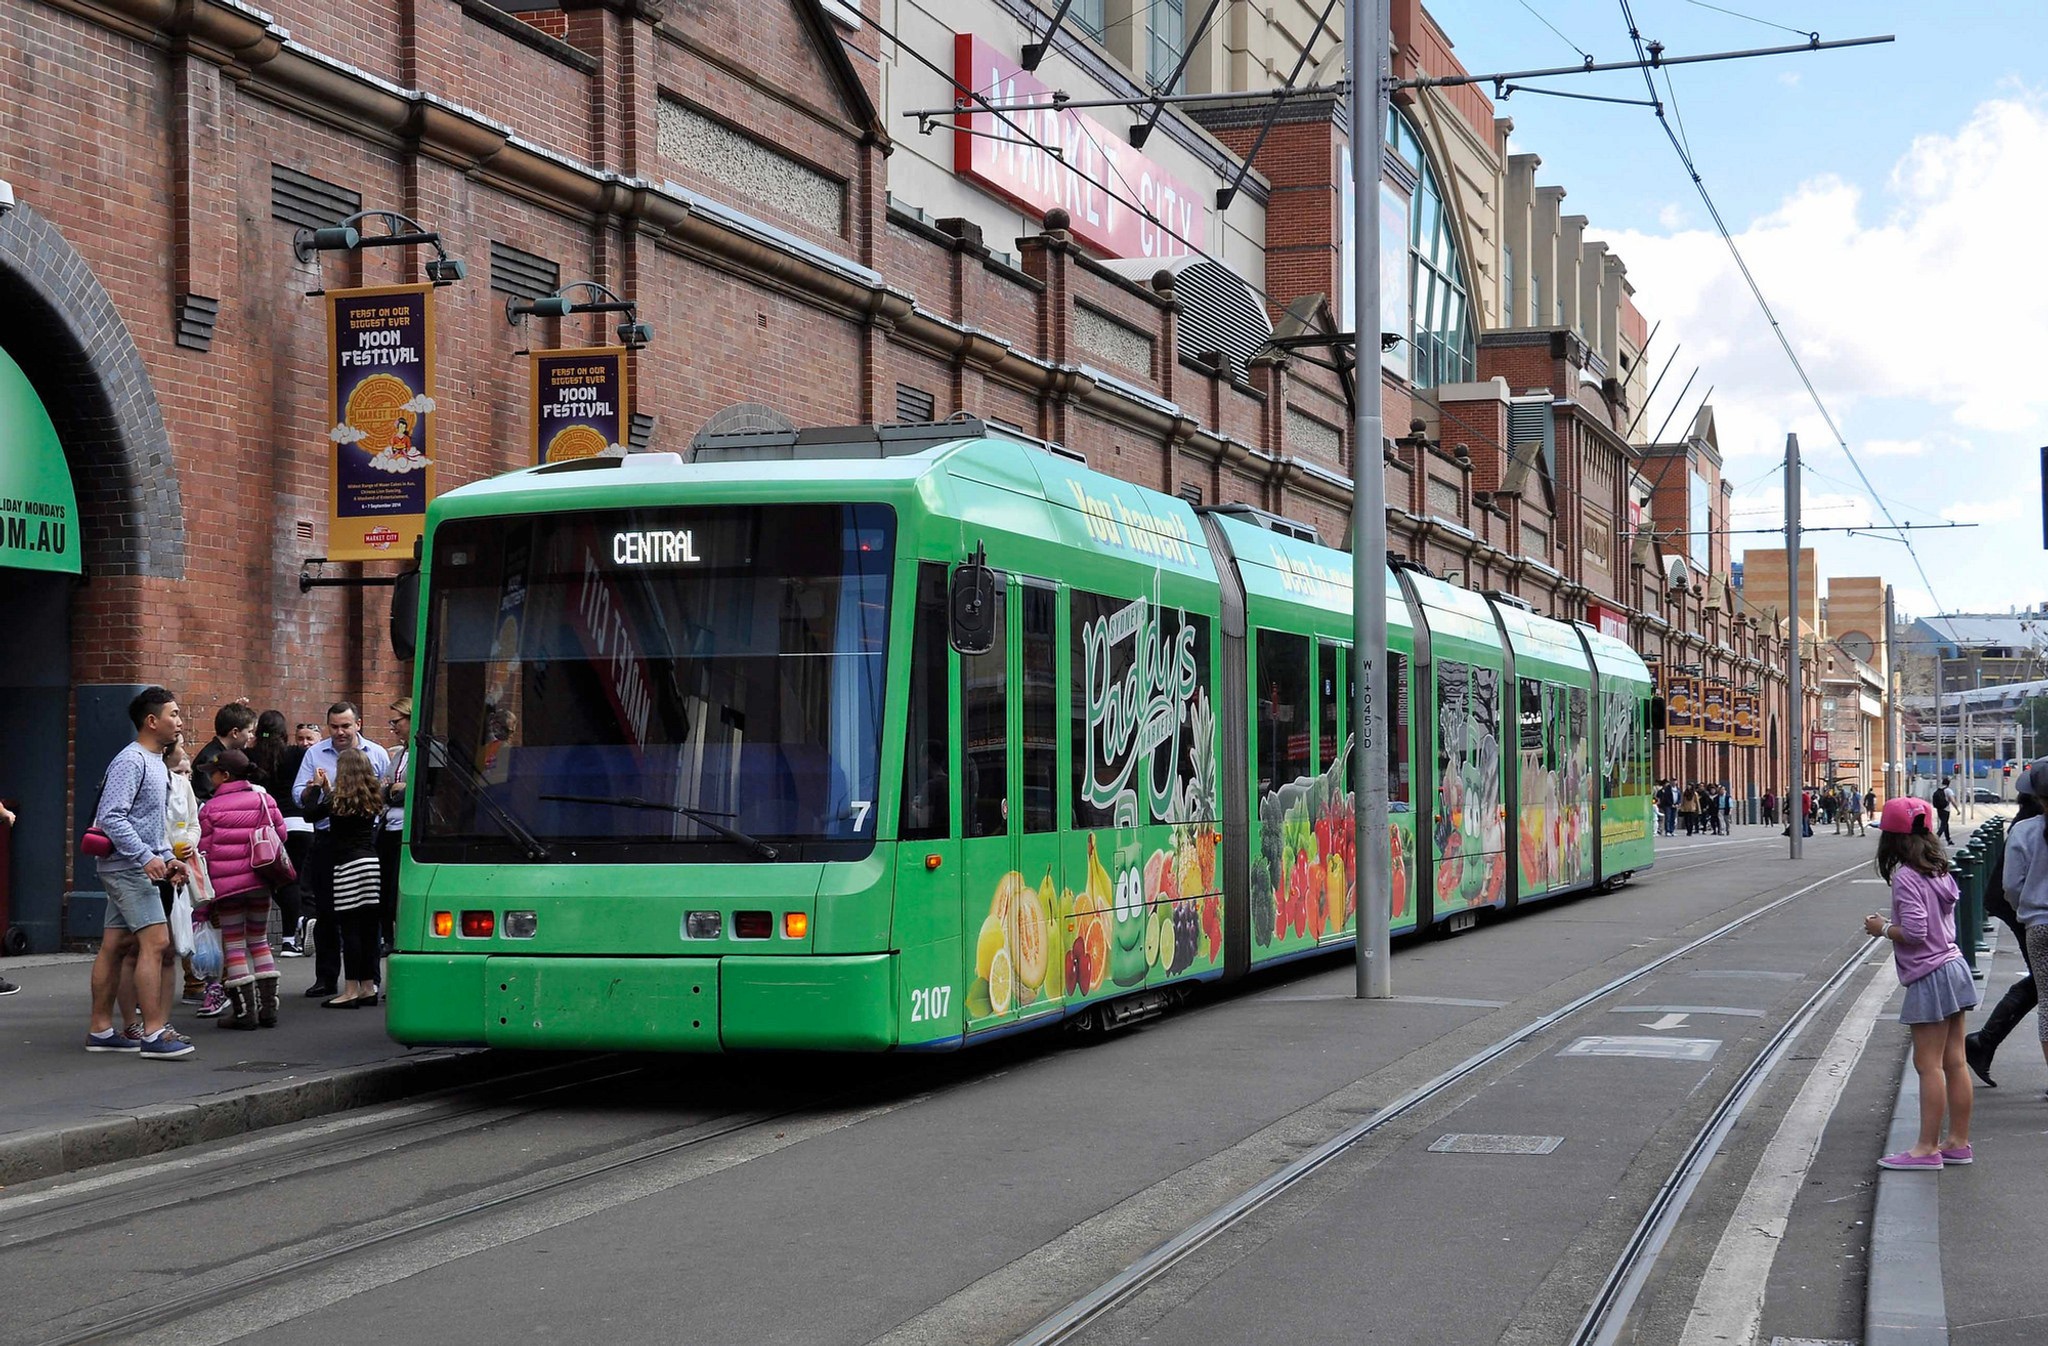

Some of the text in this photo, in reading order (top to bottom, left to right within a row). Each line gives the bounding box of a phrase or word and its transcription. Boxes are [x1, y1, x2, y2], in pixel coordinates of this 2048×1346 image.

[992, 67, 1192, 258] MARKET CITY
[350, 306, 410, 319] FEAST ON OUR
[350, 317, 410, 329] BIGGEST EVER
[359, 329, 401, 350] MOON
[341, 346, 419, 367] FESTIVAL
[551, 366, 606, 377] FEAST ON OUR
[551, 375, 606, 386] BIGGEST EVER
[559, 386, 597, 403] MOON
[543, 401, 614, 418] FESTIVAL
[24, 501, 65, 519] MONDAYS
[1065, 477, 1199, 568] You haven't
[612, 530, 701, 565] CENTRAL
[1110, 602, 1147, 642] SYDNEY'S
[1082, 563, 1197, 820] Paddy's
[850, 801, 871, 832] 7
[911, 986, 951, 1023] 2107
